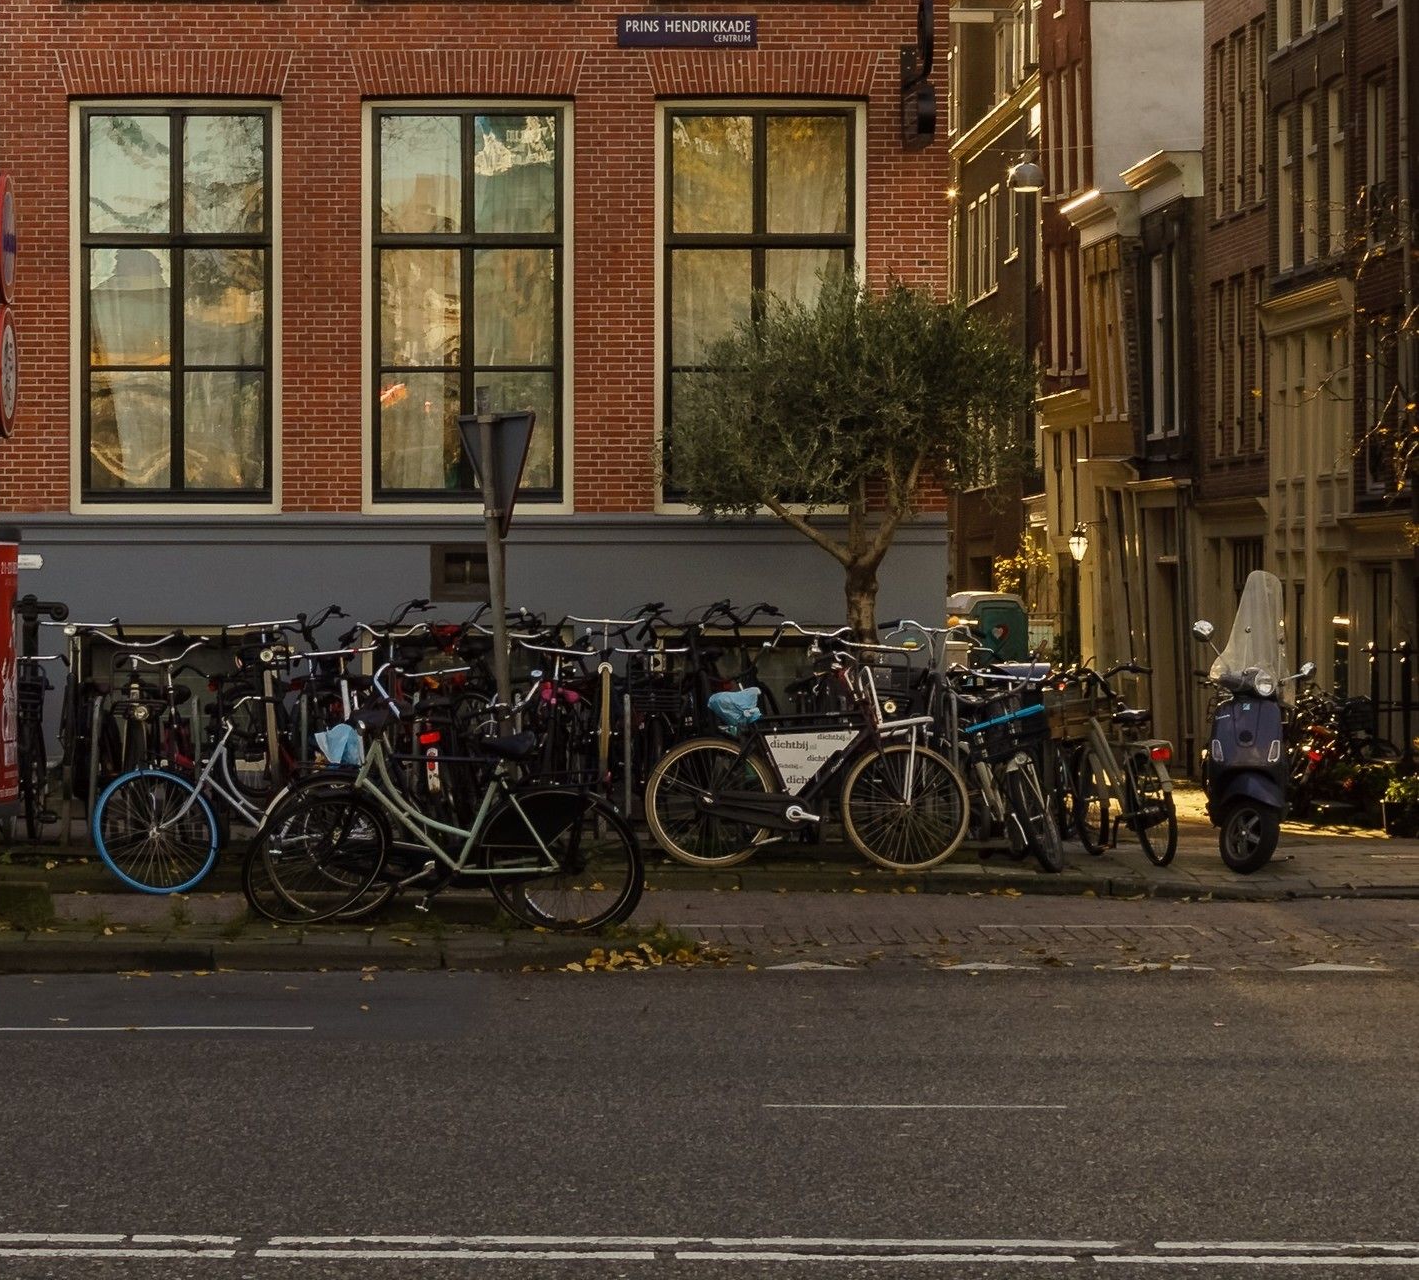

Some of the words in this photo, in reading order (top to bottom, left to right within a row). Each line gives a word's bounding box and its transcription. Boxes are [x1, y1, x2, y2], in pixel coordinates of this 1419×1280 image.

[625, 20, 660, 33] PRINS
[664, 19, 751, 33] HENDRIKKADE
[713, 34, 751, 43] CENTRUM
